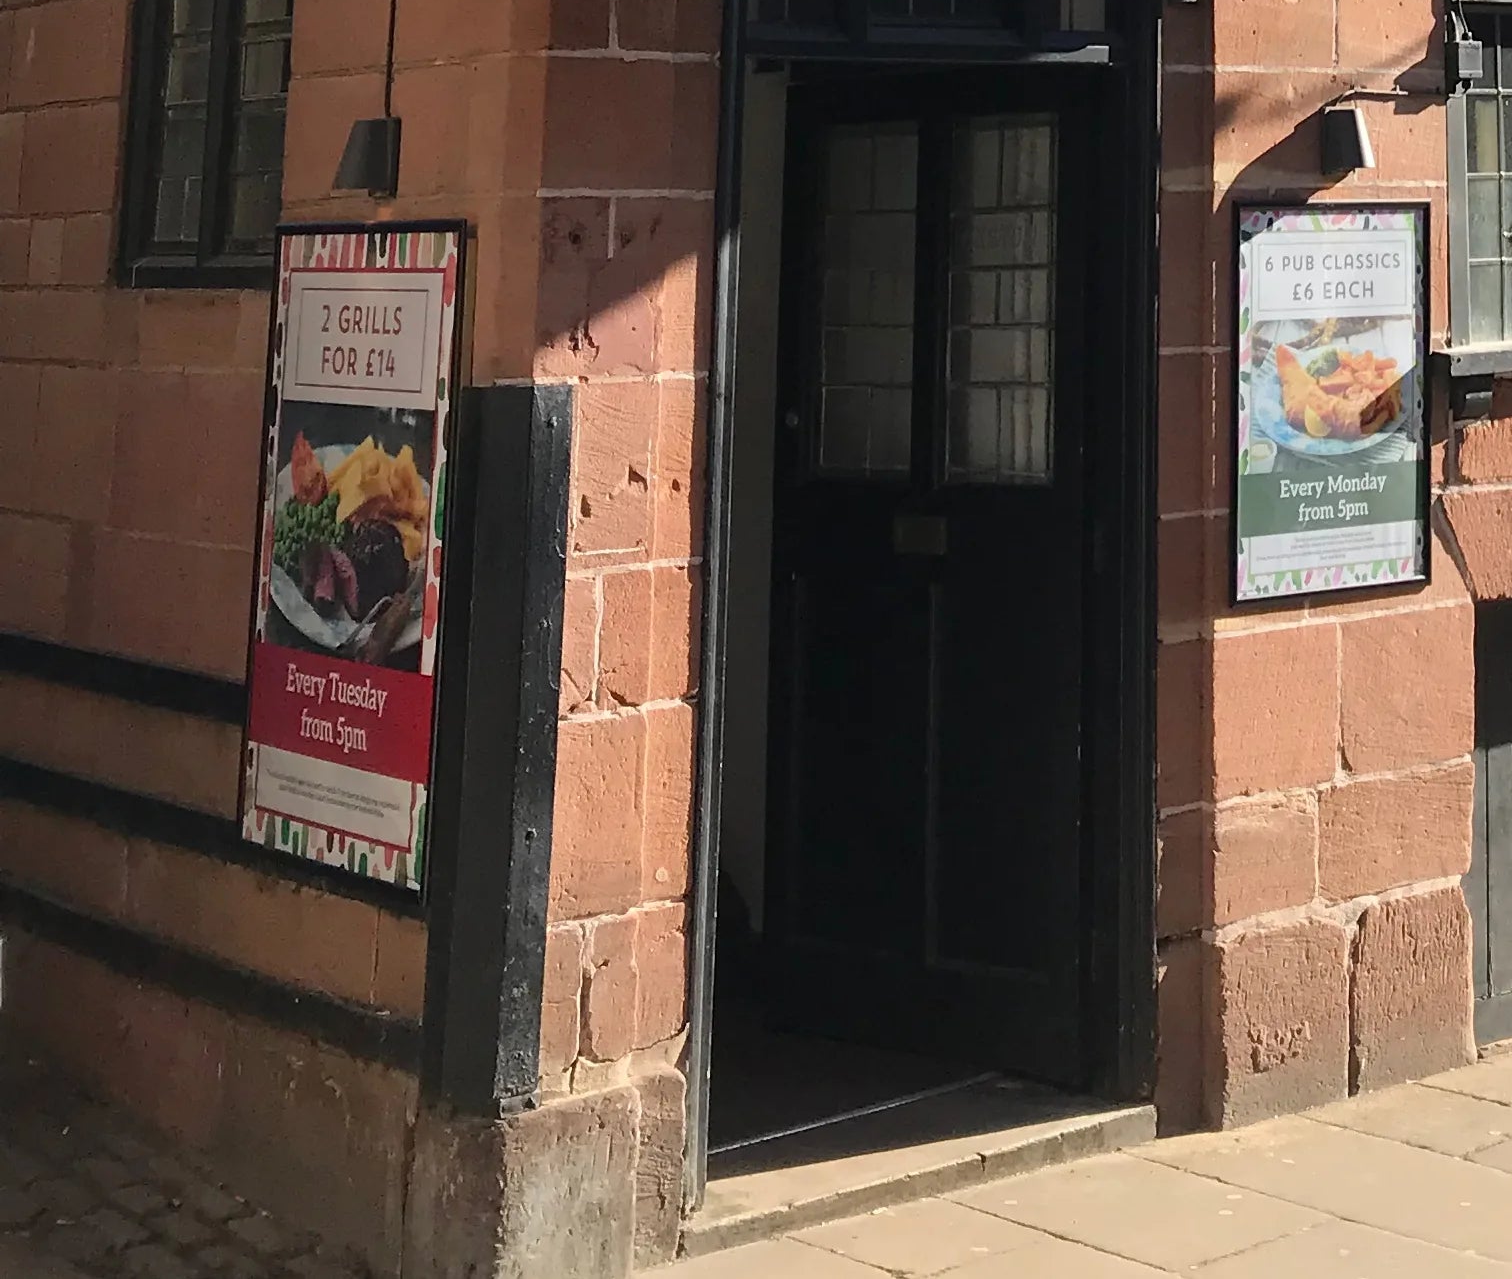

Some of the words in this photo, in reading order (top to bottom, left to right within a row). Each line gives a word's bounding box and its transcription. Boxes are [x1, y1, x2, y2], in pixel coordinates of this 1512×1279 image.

[1264, 256, 1274, 272] 6
[1282, 255, 1314, 272] PUB
[1322, 252, 1401, 271] CLASSICS
[1292, 282, 1314, 301] £6
[1323, 280, 1374, 300] EACH
[321, 304, 331, 333] 2
[338, 304, 402, 335] GRILLS
[321, 346, 357, 375] FOR
[365, 348, 395, 377] £14
[1279, 478, 1324, 499] Every
[1327, 472, 1387, 494] Monday
[1298, 503, 1334, 522] from
[1338, 499, 1369, 521] 5pm
[285, 663, 327, 705] Every
[329, 672, 388, 718] Tuesday
[300, 708, 334, 743] from
[336, 716, 367, 754] 5pm
